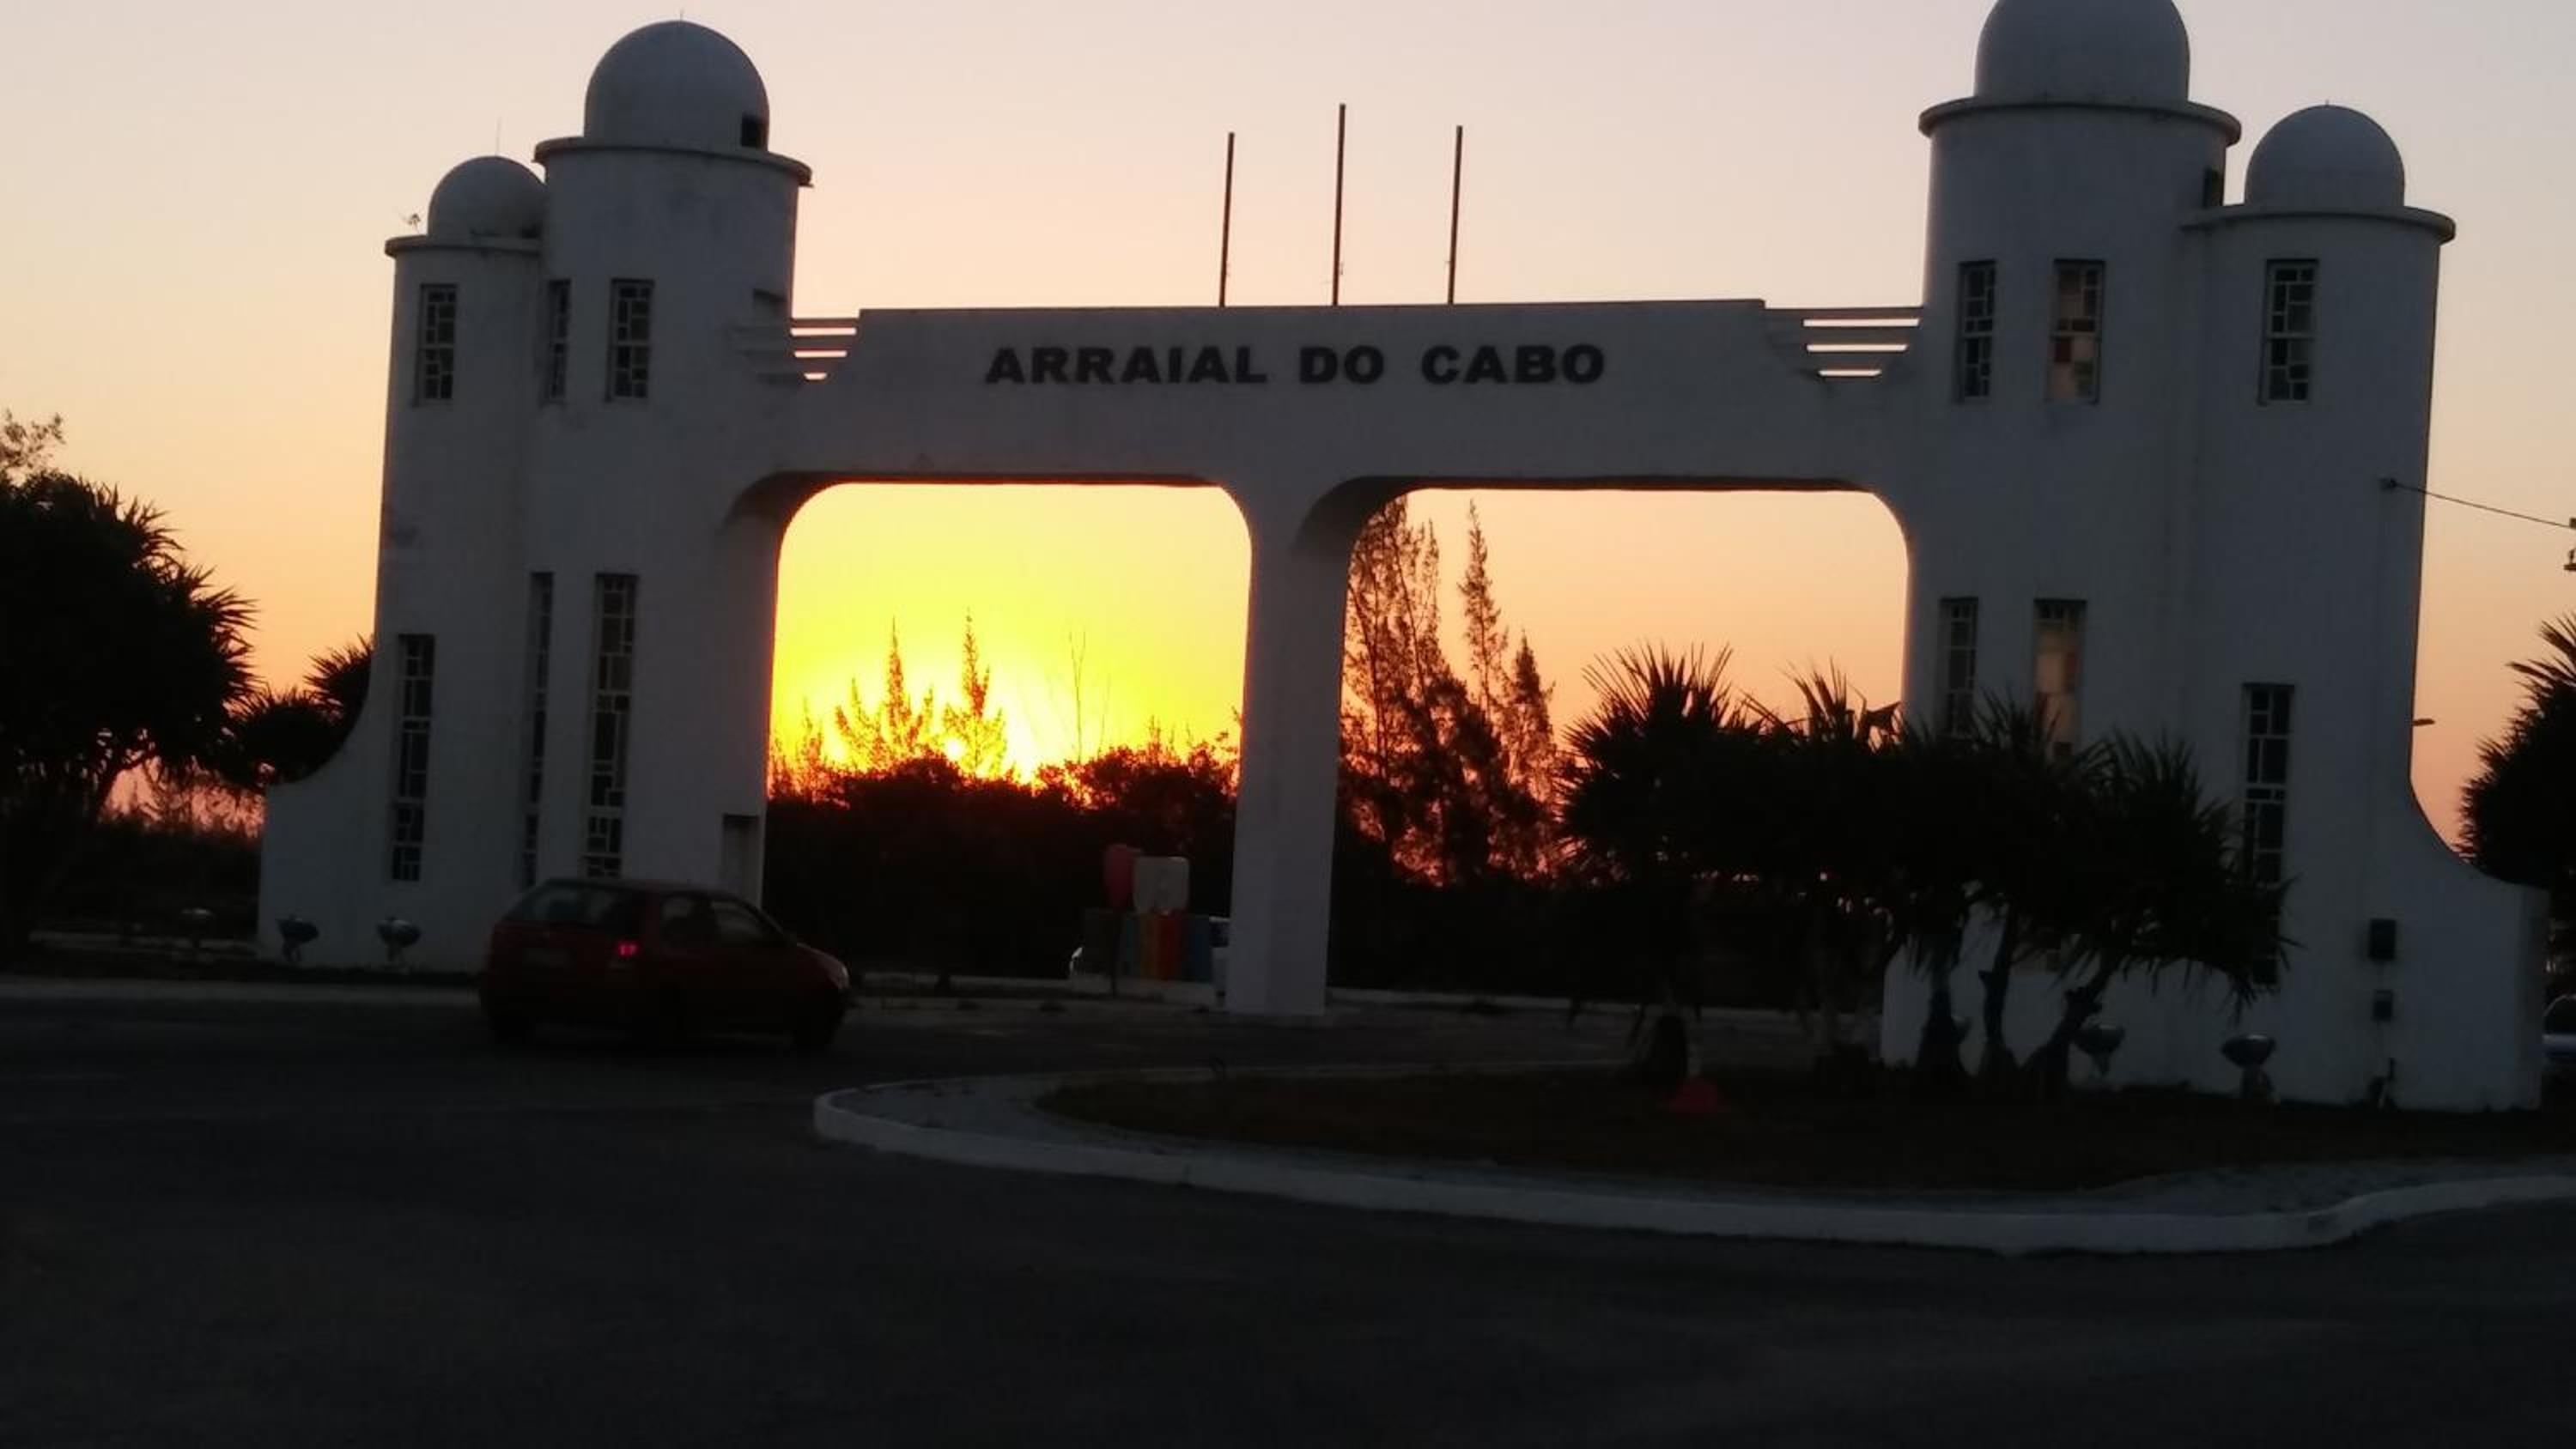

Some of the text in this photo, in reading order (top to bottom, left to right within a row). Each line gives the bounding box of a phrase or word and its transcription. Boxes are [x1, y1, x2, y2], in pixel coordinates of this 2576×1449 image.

[985, 344, 1605, 385] ARRAIAL DO CABO
